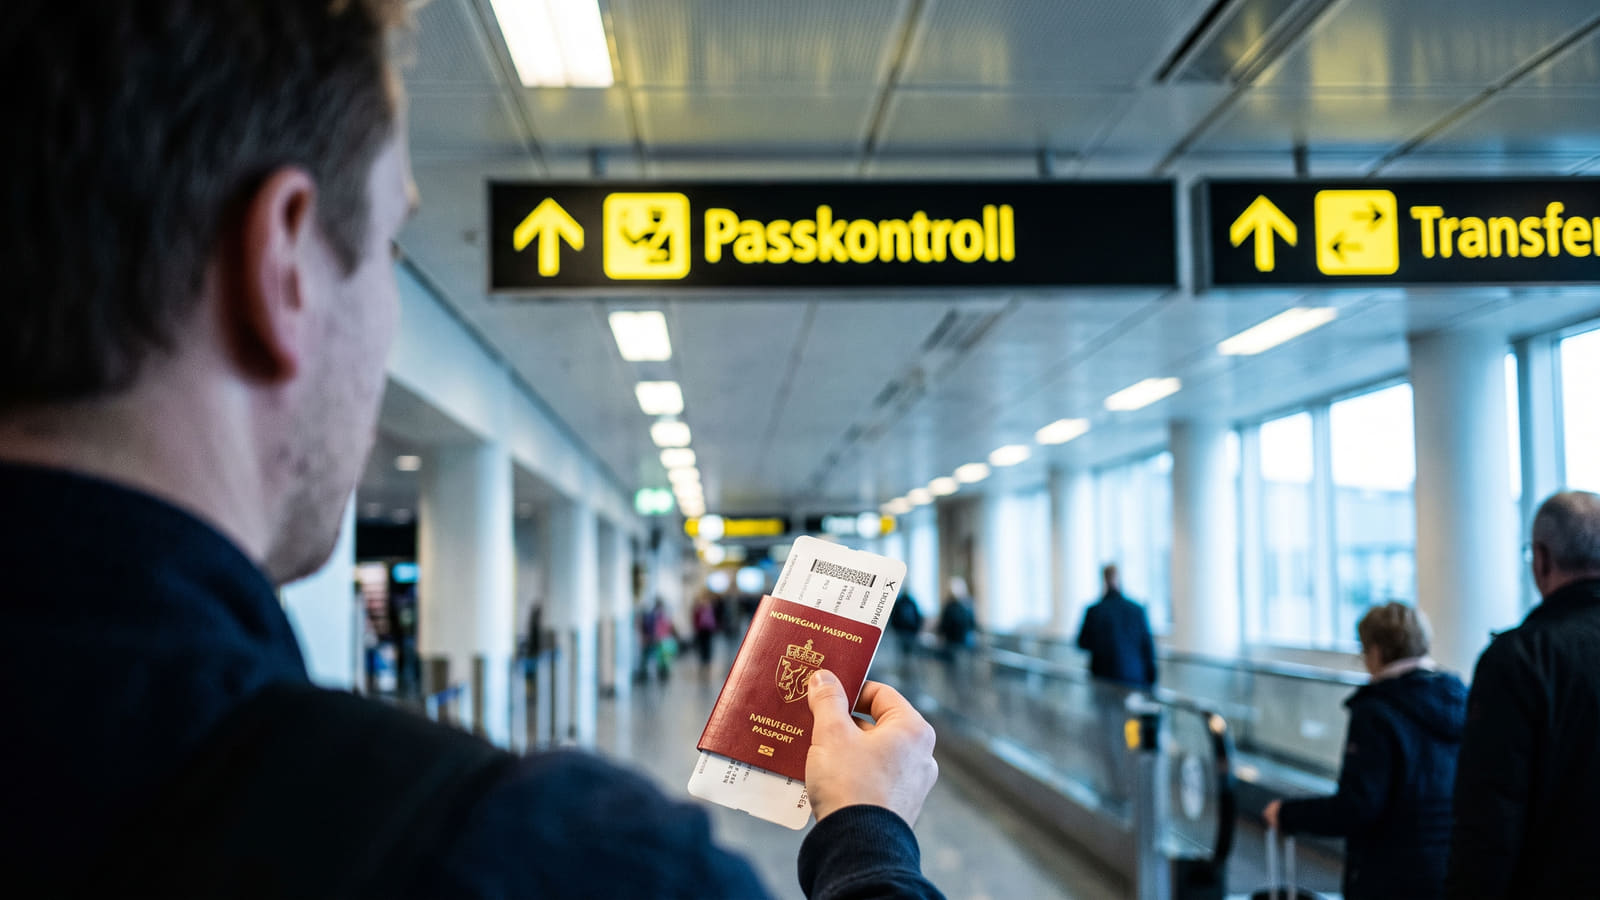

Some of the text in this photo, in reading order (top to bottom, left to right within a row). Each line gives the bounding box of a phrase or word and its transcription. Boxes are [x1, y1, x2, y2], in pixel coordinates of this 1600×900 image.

[704, 204, 1015, 264] Passkontroll
[769, 610, 821, 631] NORWEGIAN
[751, 724, 795, 744] PASSPORT
